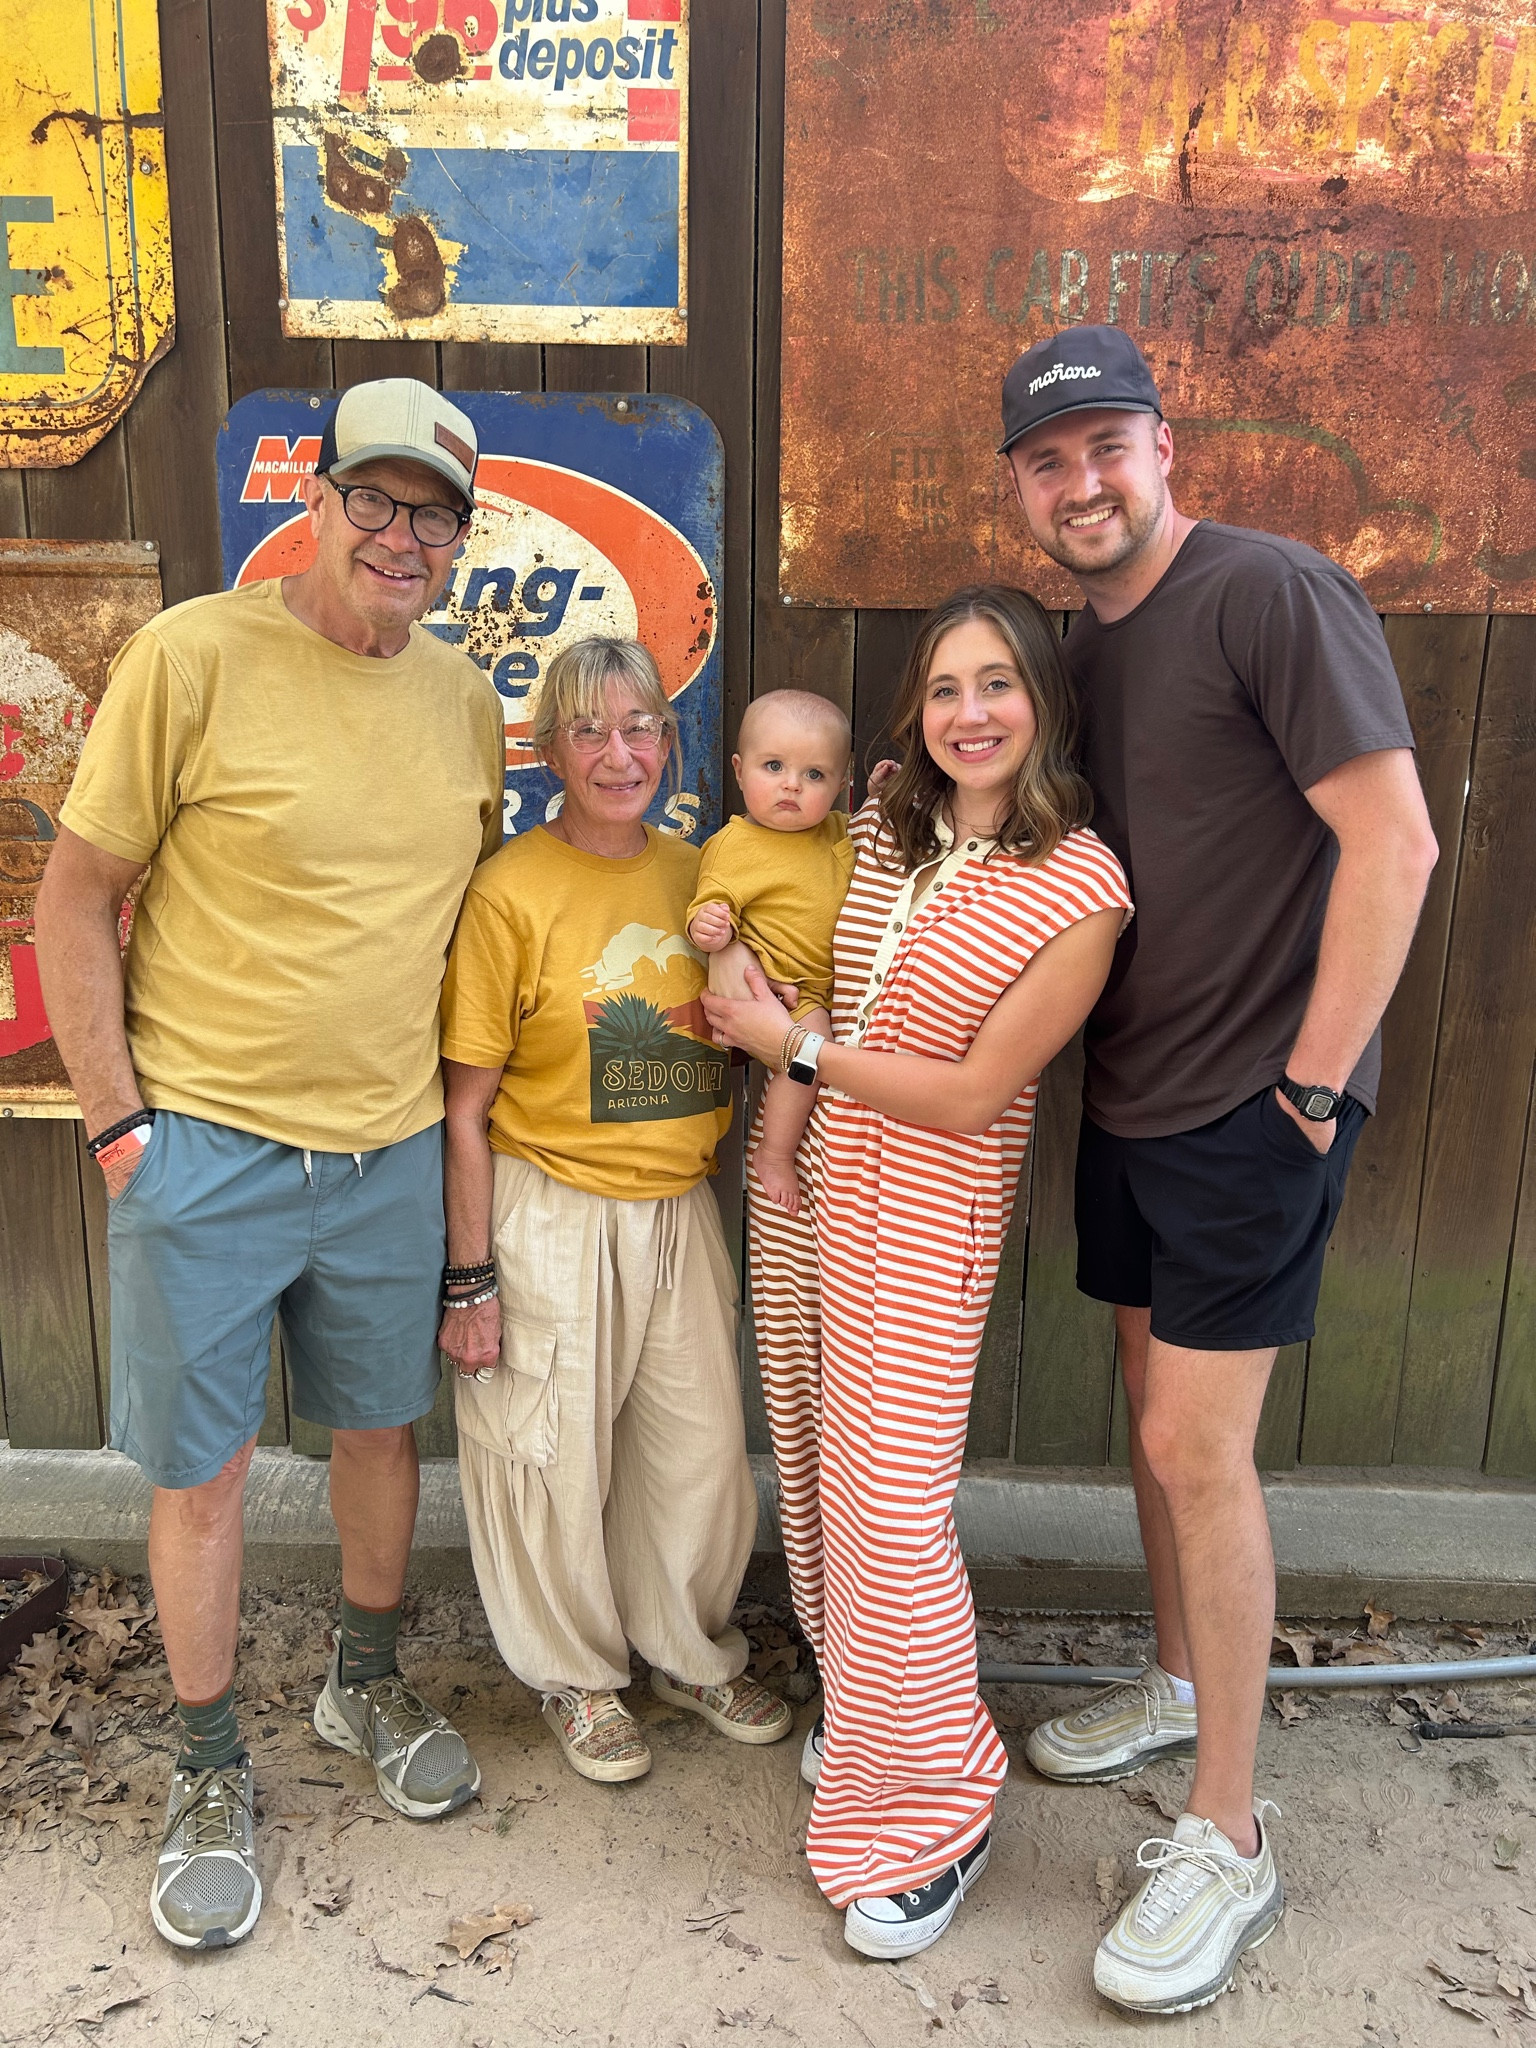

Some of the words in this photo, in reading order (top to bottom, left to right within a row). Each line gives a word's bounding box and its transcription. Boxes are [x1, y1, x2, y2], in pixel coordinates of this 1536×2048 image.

[498, 28, 678, 91] deposit
[850, 246, 961, 325] THIS
[983, 248, 1090, 325] CAB
[1105, 249, 1222, 328] FITS
[1438, 249, 1536, 328] MO
[1029, 363, 1101, 395] mañana
[430, 543, 605, 637] ing-
[607, 1094, 670, 1110] ARIZONA
